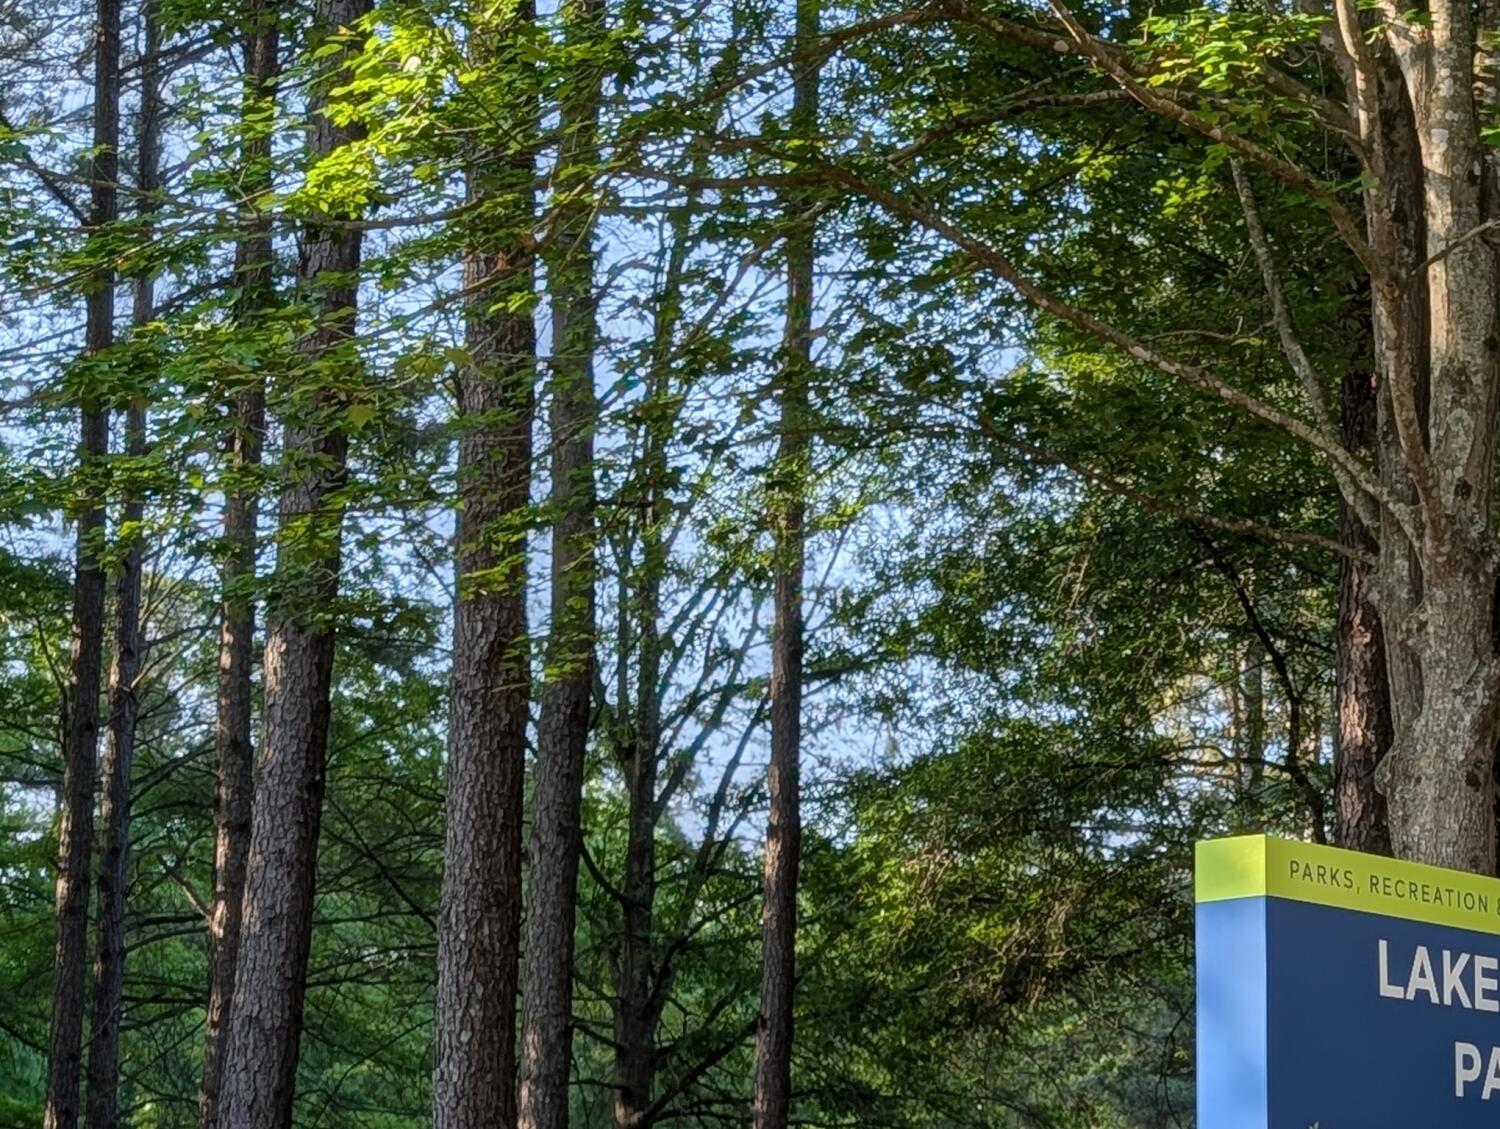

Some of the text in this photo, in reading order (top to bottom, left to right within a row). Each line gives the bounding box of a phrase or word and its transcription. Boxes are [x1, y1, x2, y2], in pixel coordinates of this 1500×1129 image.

[1289, 859, 1360, 894] PARKS,
[1369, 874, 1489, 914] RECREATION
[1378, 938, 1500, 1013] LAKE
